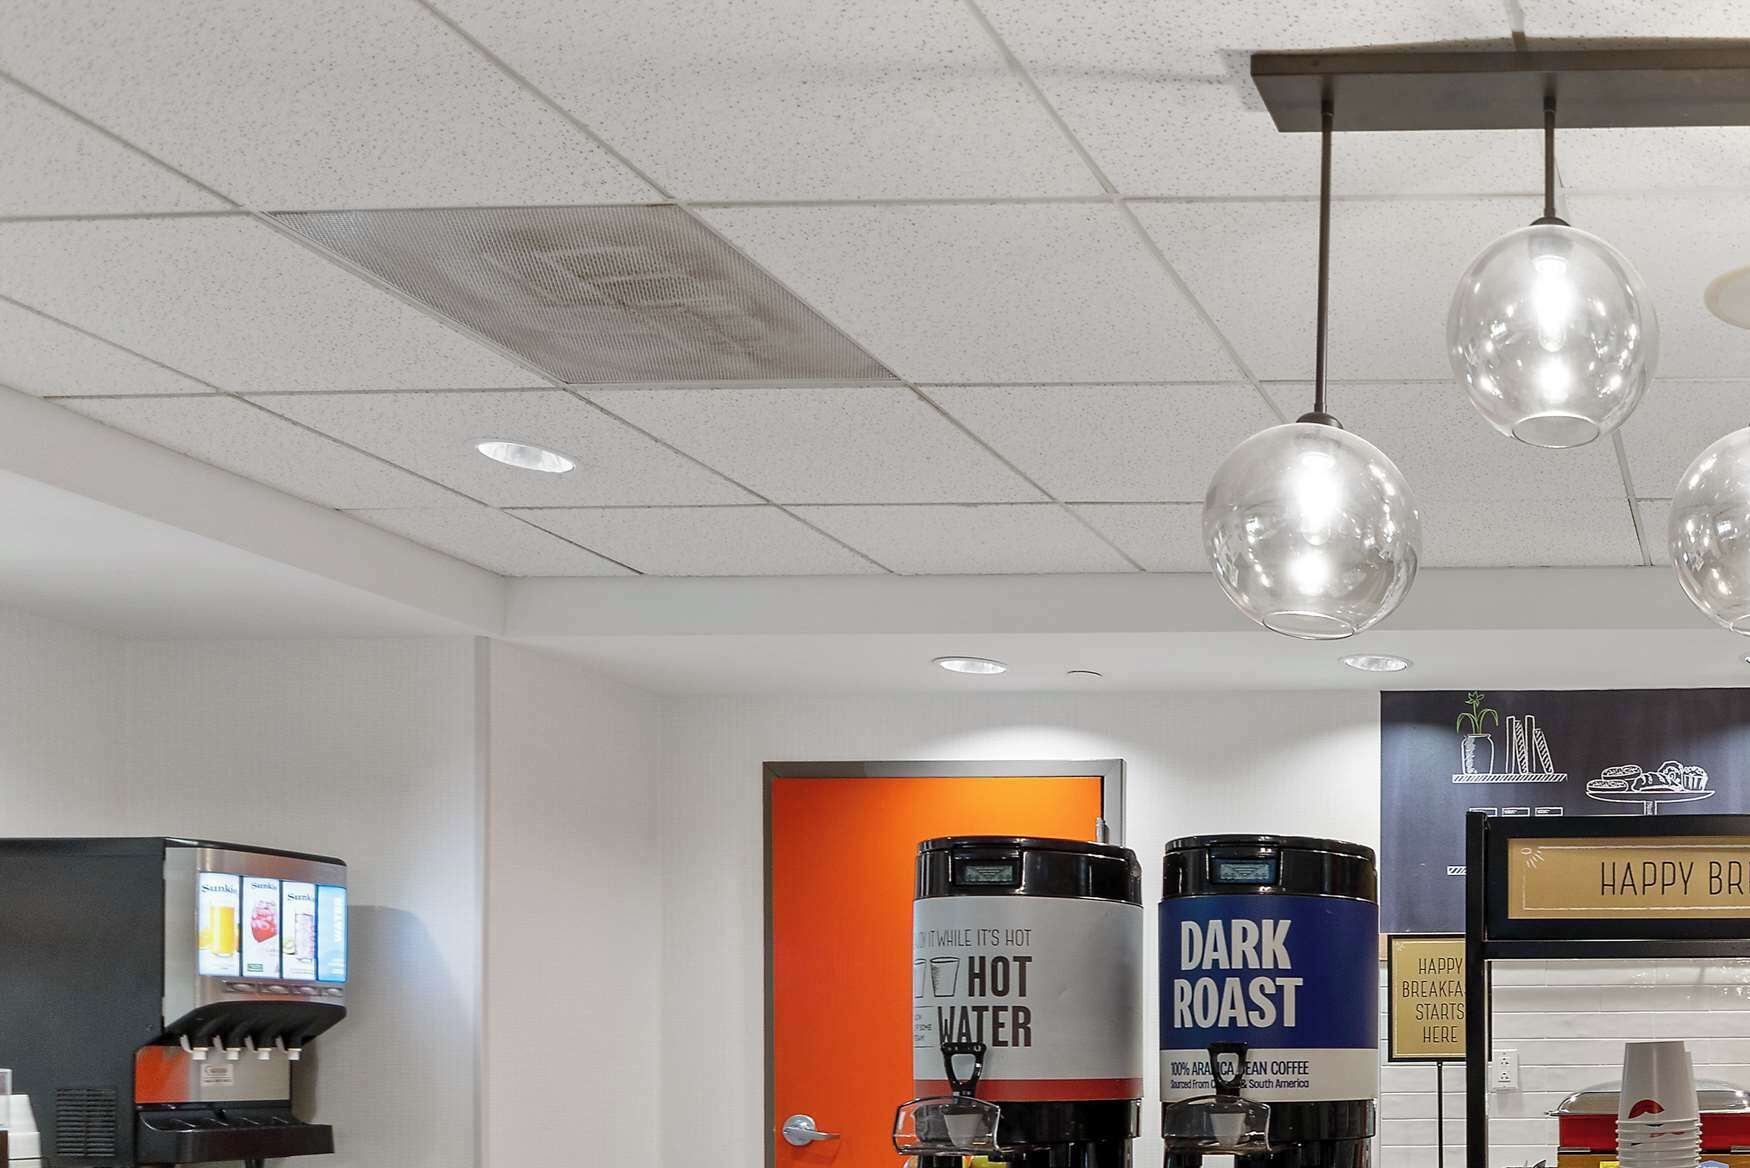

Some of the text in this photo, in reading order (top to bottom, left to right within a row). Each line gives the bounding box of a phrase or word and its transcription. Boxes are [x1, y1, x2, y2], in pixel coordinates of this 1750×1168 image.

[1600, 861, 1694, 896] HAPPY
[201, 884, 237, 893] Sunkis
[936, 928, 972, 947] WHILE
[977, 928, 1000, 946] IT'S
[1005, 928, 1032, 946] HOT
[1181, 919, 1292, 971] DARK
[1418, 957, 1463, 975] HAPPY
[967, 955, 1033, 998] HOT
[1402, 980, 1465, 998] BREAKFA
[1173, 976, 1304, 1029] ROAST
[1415, 1002, 1465, 1021] STARTS
[937, 1005, 1032, 1047] WATER
[1423, 1025, 1459, 1043] HERE
[1170, 1061, 1190, 1076] 100%
[1191, 1061, 1234, 1076] ARAICA
[1270, 1060, 1309, 1076] COFFEE
[1193, 1079, 1209, 1089] From
[1248, 1078, 1274, 1089] South
[1275, 1078, 1309, 1089] America
